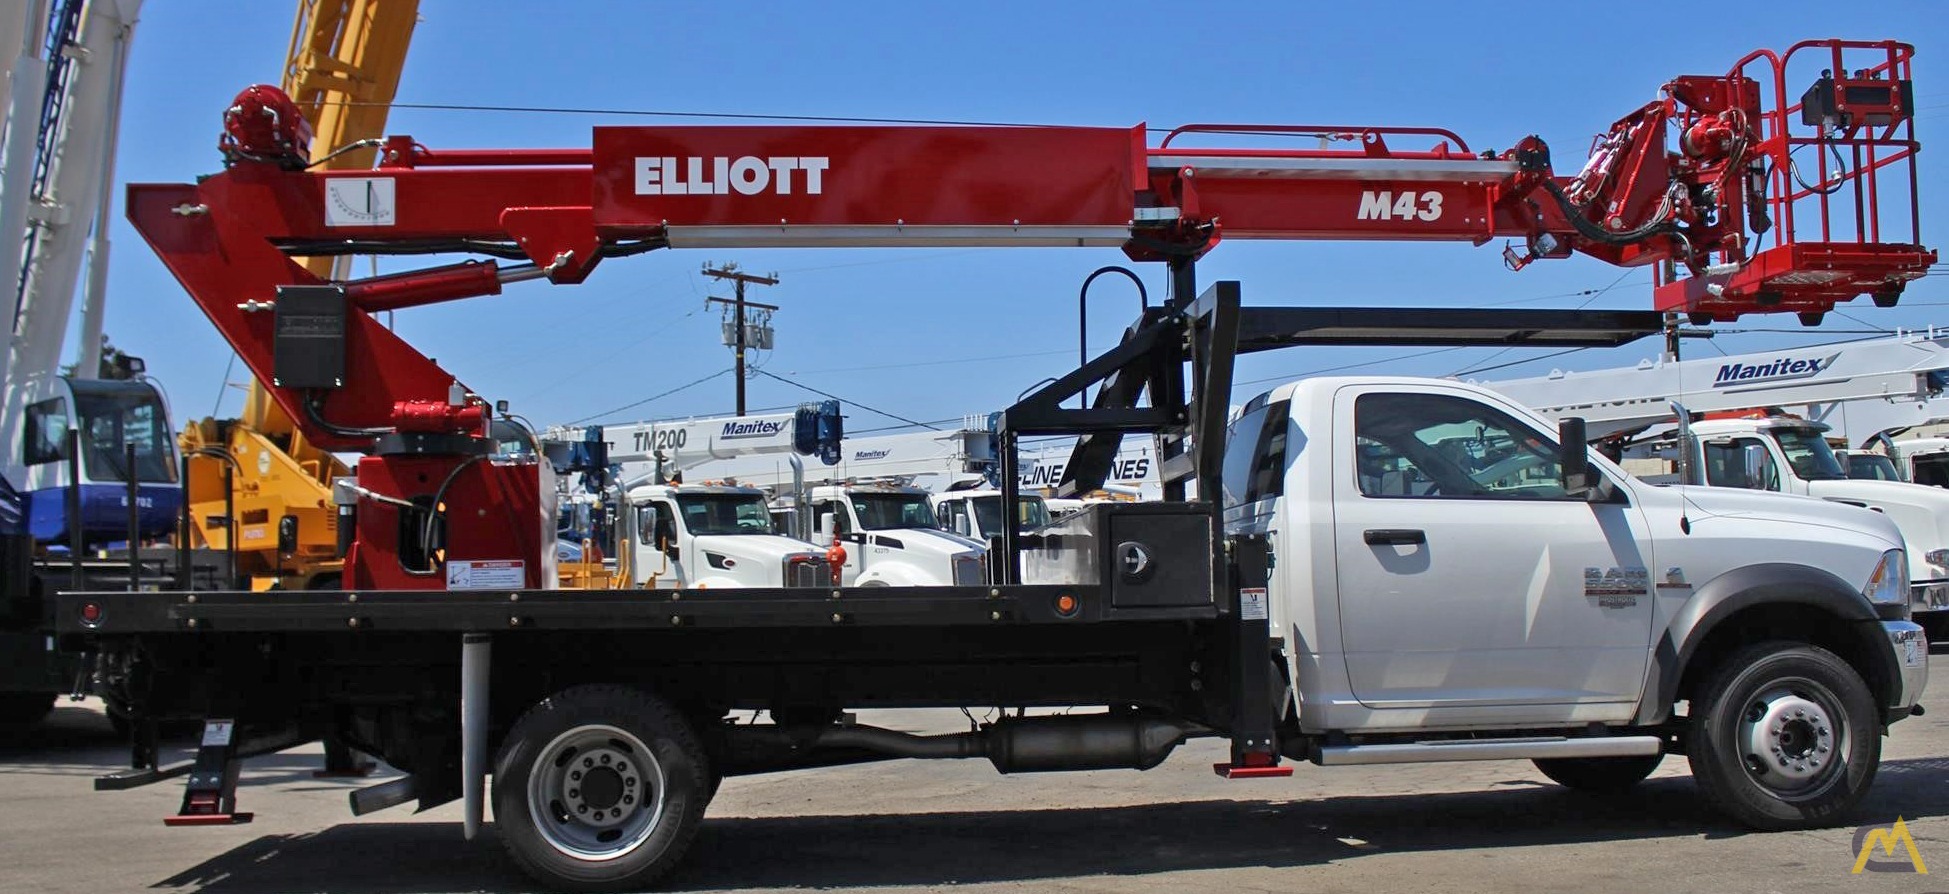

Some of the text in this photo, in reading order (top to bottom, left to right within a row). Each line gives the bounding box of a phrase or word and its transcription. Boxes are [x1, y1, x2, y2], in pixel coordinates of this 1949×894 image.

[635, 156, 829, 195] ELLIOTT
[1357, 191, 1444, 222] M43
[1716, 358, 1823, 382] Manitex
[633, 428, 687, 452] TM200
[722, 420, 782, 436] Manitex
[855, 450, 888, 459] Manitex
